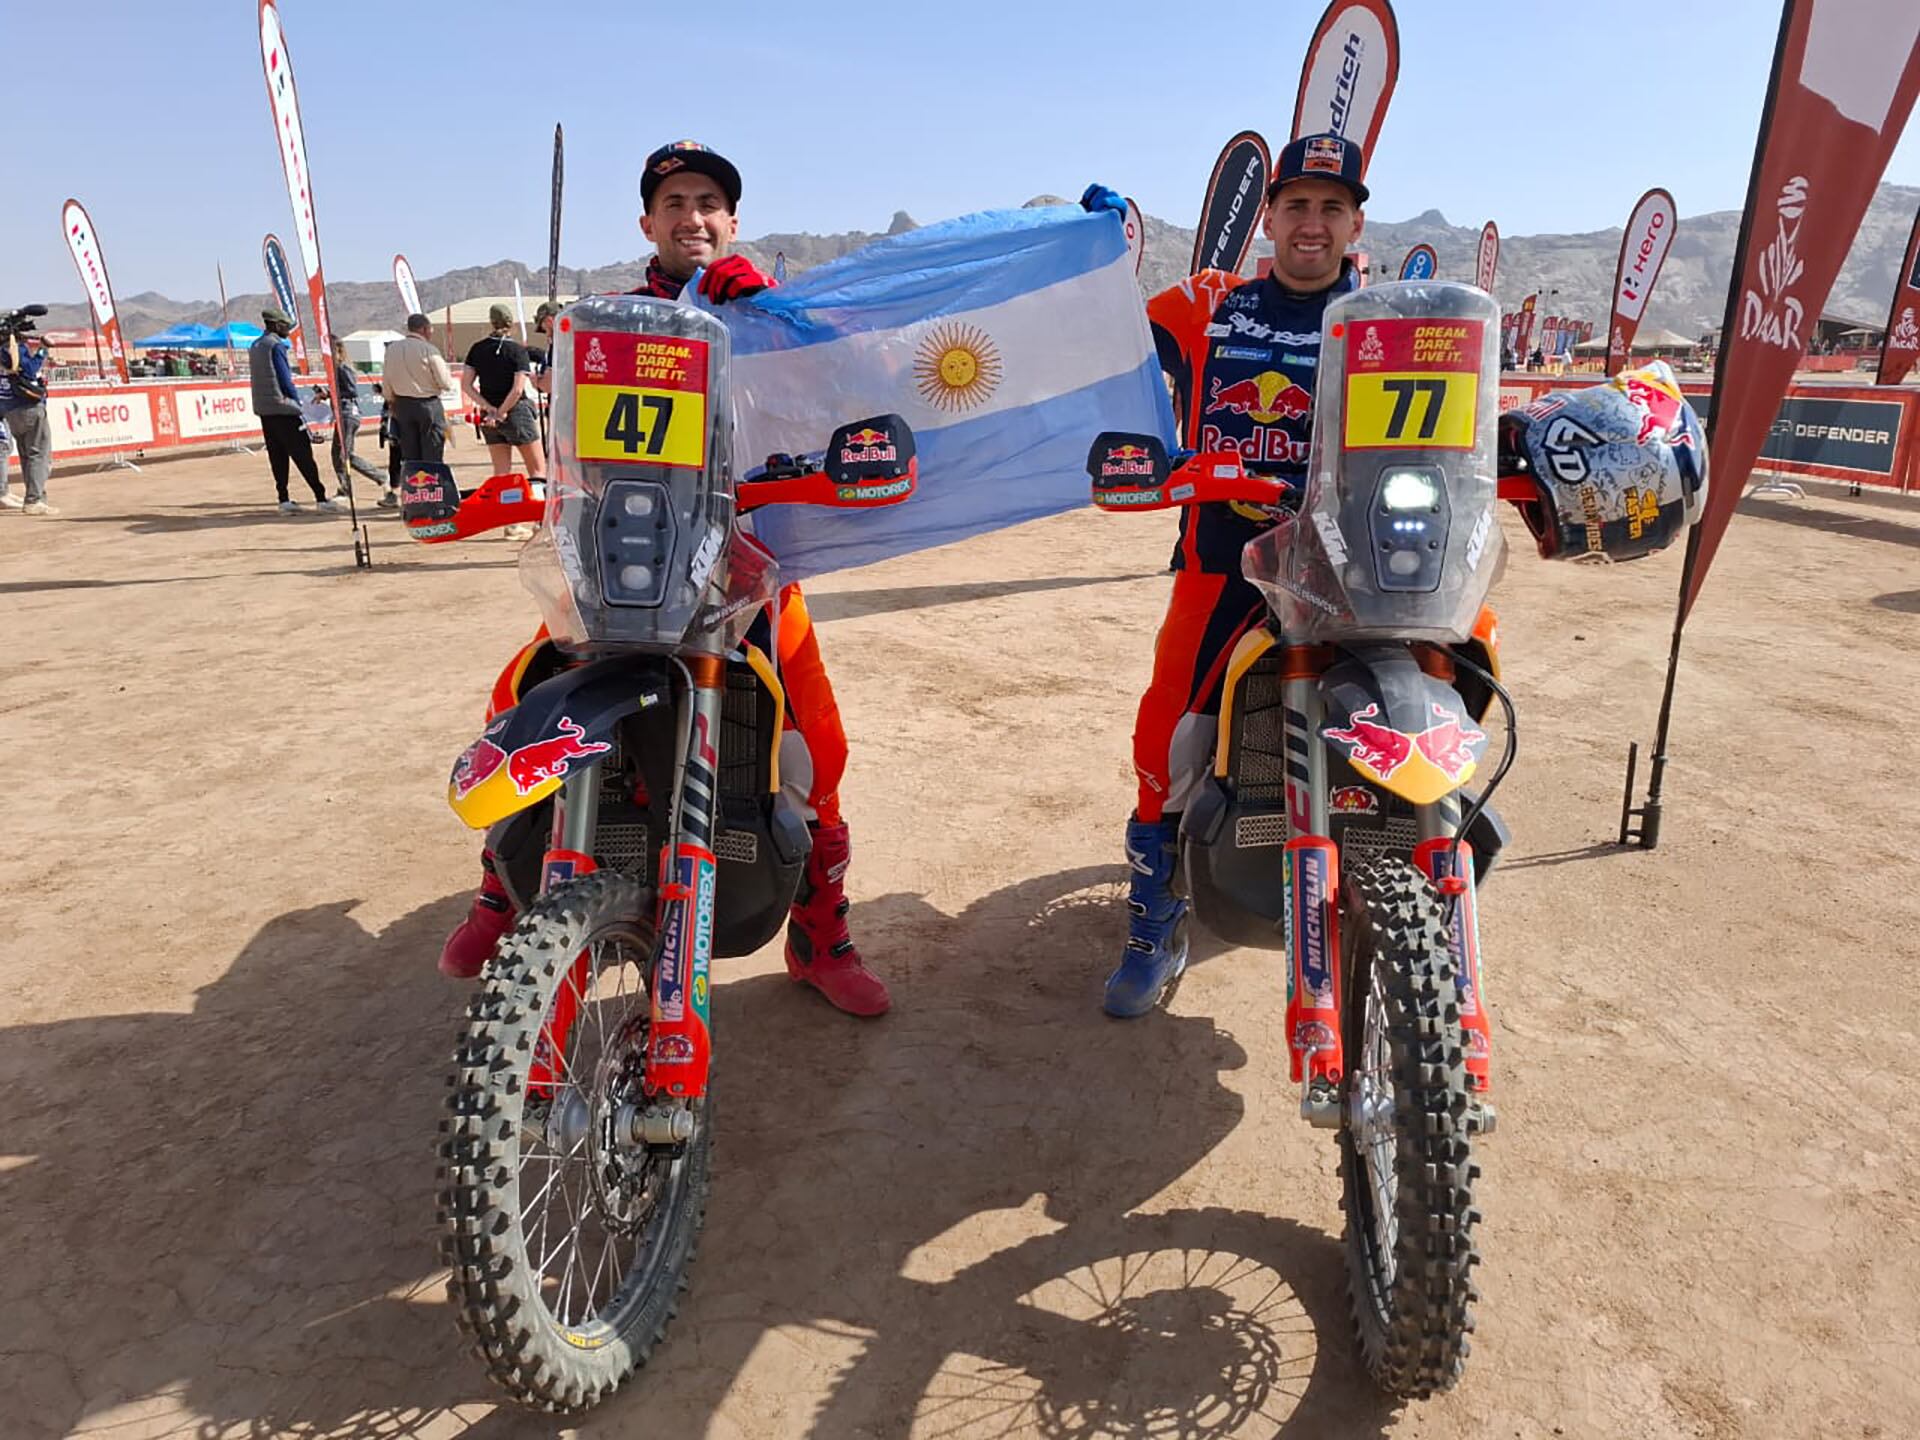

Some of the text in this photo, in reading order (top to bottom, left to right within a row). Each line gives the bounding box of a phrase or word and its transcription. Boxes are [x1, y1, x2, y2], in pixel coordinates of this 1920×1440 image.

[1329, 32, 1360, 136] drich
[1209, 156, 1259, 271] FENDER
[1633, 212, 1664, 274] Hero
[1414, 326, 1469, 338] DREAM.
[636, 342, 693, 358] DREAM.
[1413, 338, 1456, 350] DARE.
[636, 354, 679, 369] DARE.
[1413, 351, 1463, 363] LIVE IT.
[636, 366, 687, 381] LIVE IT.
[86, 404, 129, 425] Hero
[212, 397, 246, 415] Hero
[1383, 379, 1447, 438] 77
[604, 392, 674, 455] 47
[1203, 424, 1312, 462] Red Bu
[1795, 424, 1890, 444] DEFENDER
[841, 446, 897, 463] Red Bull
[1102, 460, 1154, 476] Red Bull
[856, 479, 911, 499] MOTOREX
[1105, 491, 1159, 503] MOTOREX
[694, 865, 714, 972] MOTOREX
[1306, 856, 1321, 970] MICHELIN
